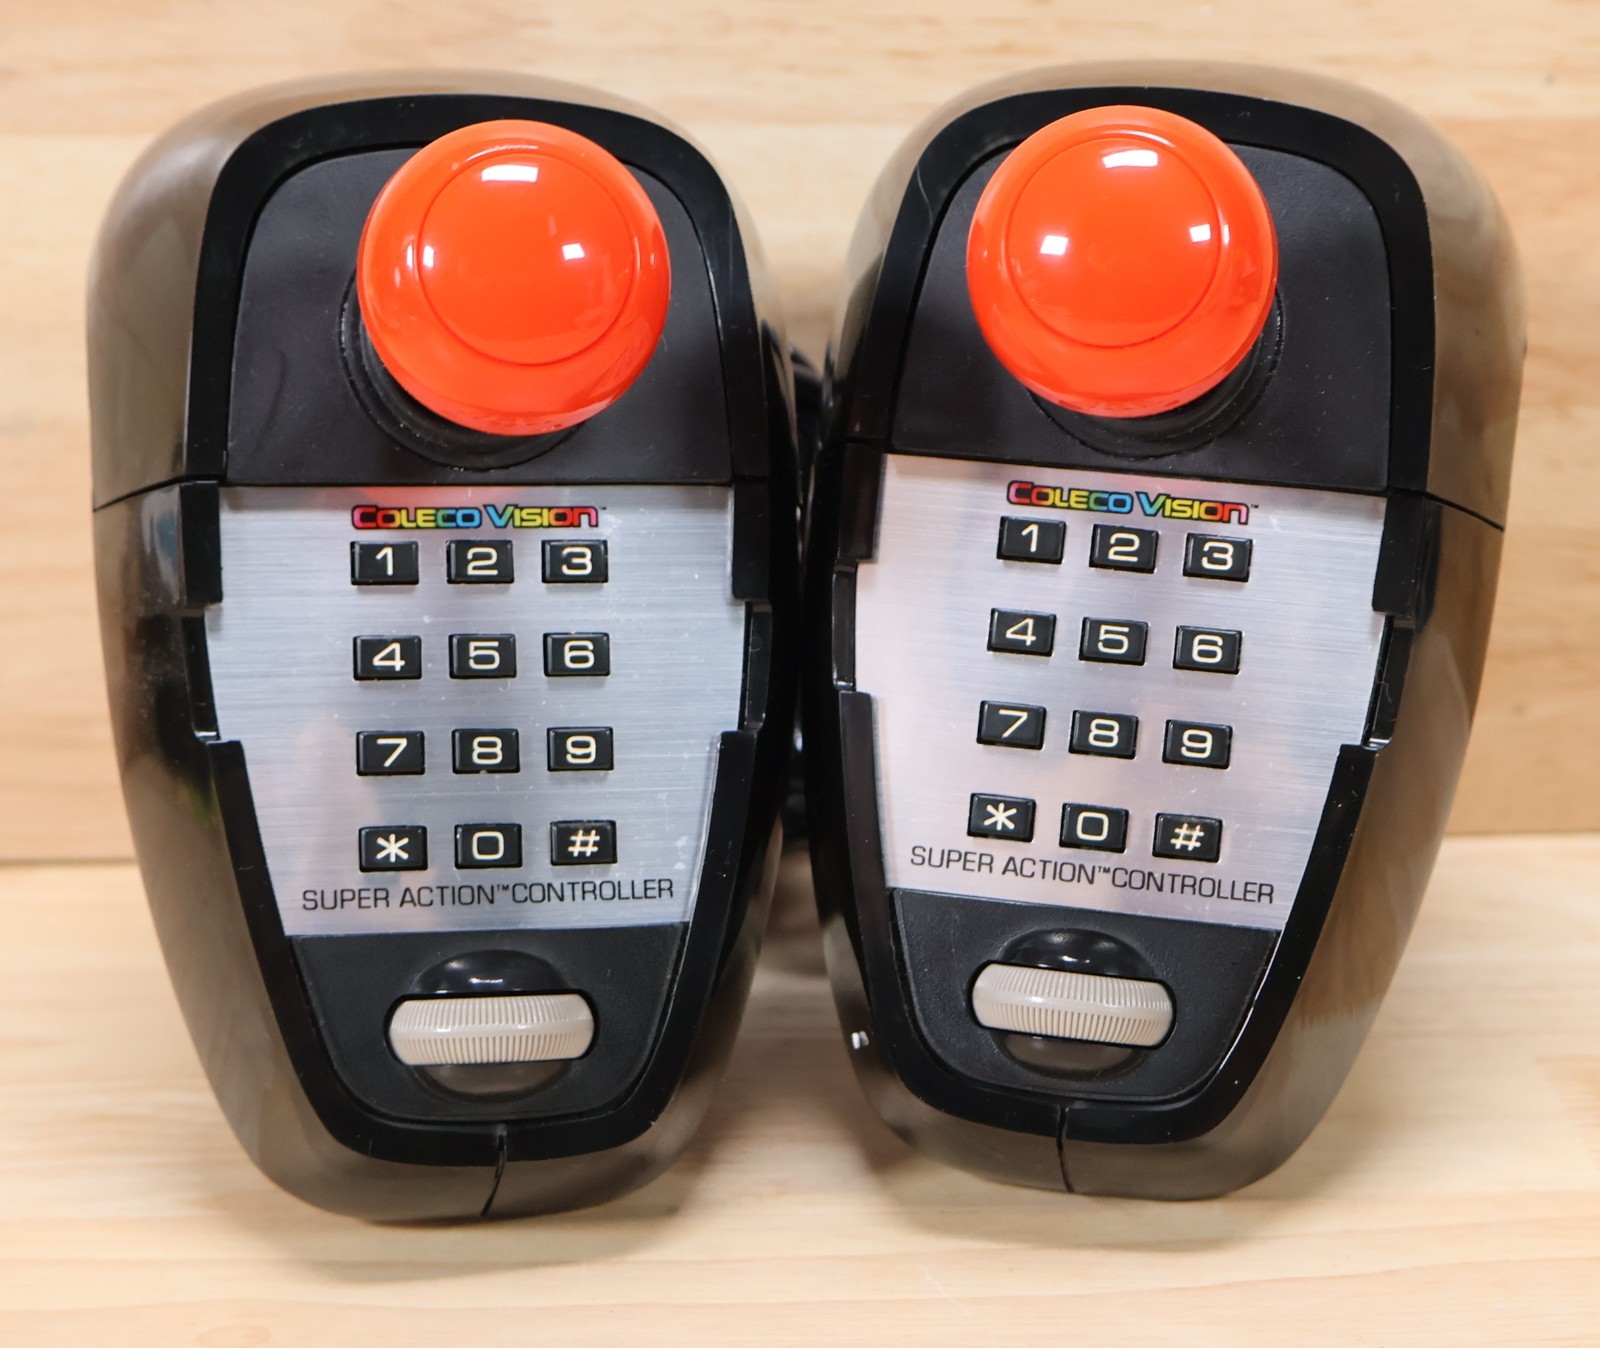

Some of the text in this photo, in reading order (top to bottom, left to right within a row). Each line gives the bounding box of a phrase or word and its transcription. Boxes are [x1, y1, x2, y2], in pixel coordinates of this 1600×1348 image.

[1021, 523, 1038, 553] 1
[1108, 532, 1140, 562] 2
[375, 546, 394, 576] 1
[466, 547, 498, 575] 2
[561, 546, 592, 575] 3
[1201, 541, 1233, 571] 3
[1005, 617, 1036, 646] 4
[1097, 625, 1129, 654] 5
[372, 642, 405, 672] 4
[468, 641, 500, 670] 5
[564, 640, 595, 669] 6
[1192, 634, 1223, 664] 6
[998, 709, 1028, 739] 7
[1088, 718, 1120, 748] 8
[376, 737, 408, 768] 7
[472, 736, 503, 765] 8
[566, 735, 596, 764] 9
[1181, 729, 1212, 758] 9
[568, 829, 600, 857] #
[1170, 822, 1204, 851] #
[910, 845, 993, 874] SUPER
[1111, 867, 1274, 904] CONTROLLER
[302, 887, 390, 911] SUPER
[512, 878, 673, 903] CONTROLLER
